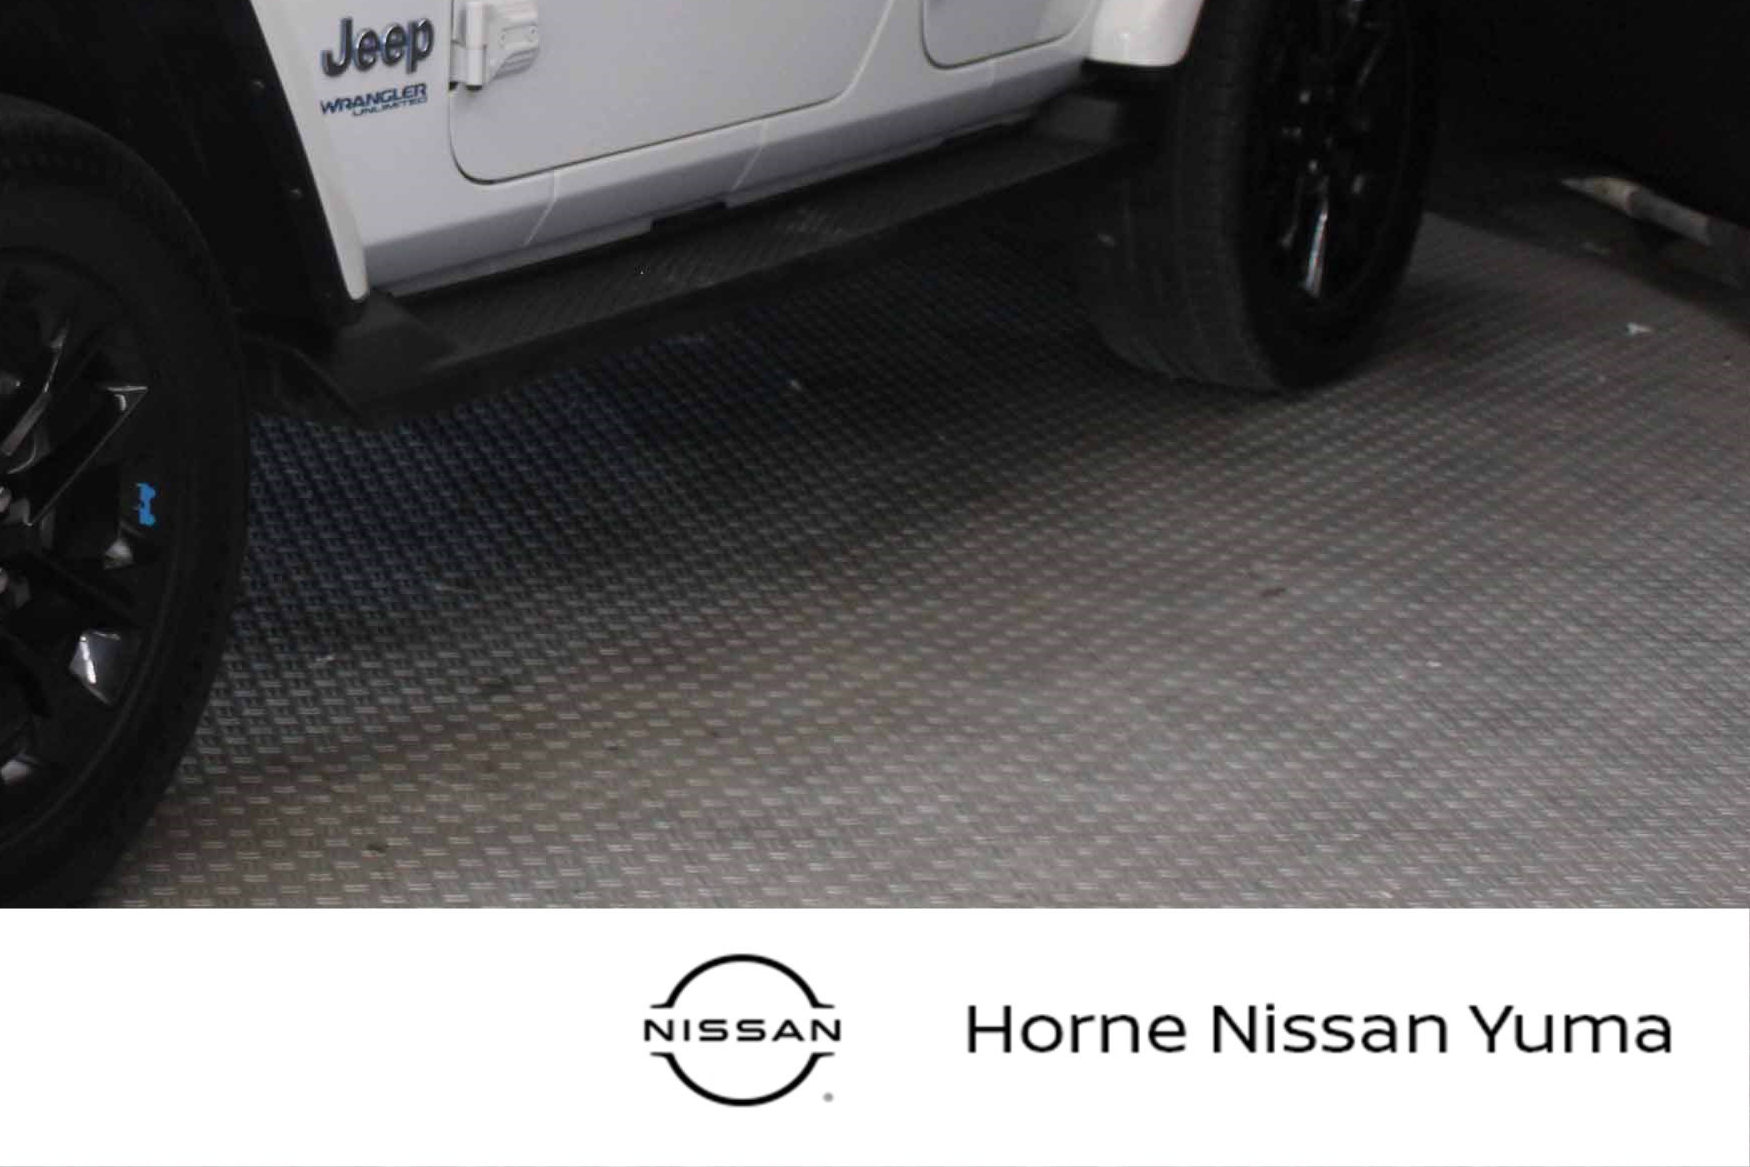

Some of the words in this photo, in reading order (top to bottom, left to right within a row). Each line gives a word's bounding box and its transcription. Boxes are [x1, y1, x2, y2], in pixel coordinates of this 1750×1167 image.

[321, 16, 435, 77] Jeep
[320, 83, 428, 115] WRANGLER
[352, 97, 428, 117] UNLIMITED
